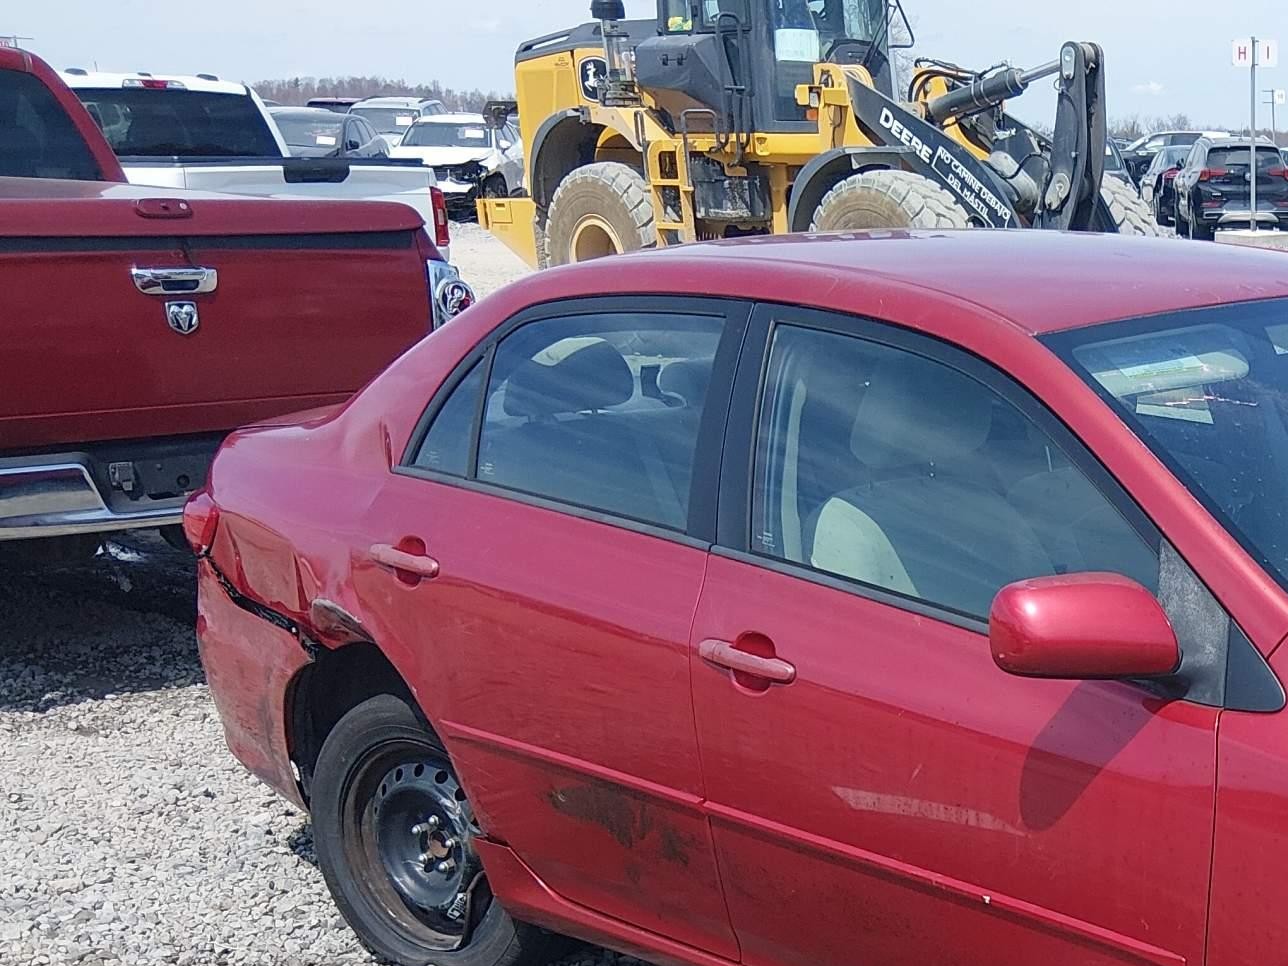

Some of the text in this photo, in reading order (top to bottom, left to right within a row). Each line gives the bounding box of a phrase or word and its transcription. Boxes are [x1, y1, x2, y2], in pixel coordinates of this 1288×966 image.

[1238, 46, 1247, 60] H
[880, 108, 933, 163] DEERE
[939, 148, 1011, 221] NO CAMINE DEBAJO
[947, 173, 989, 219] DEL MÁSTIL
